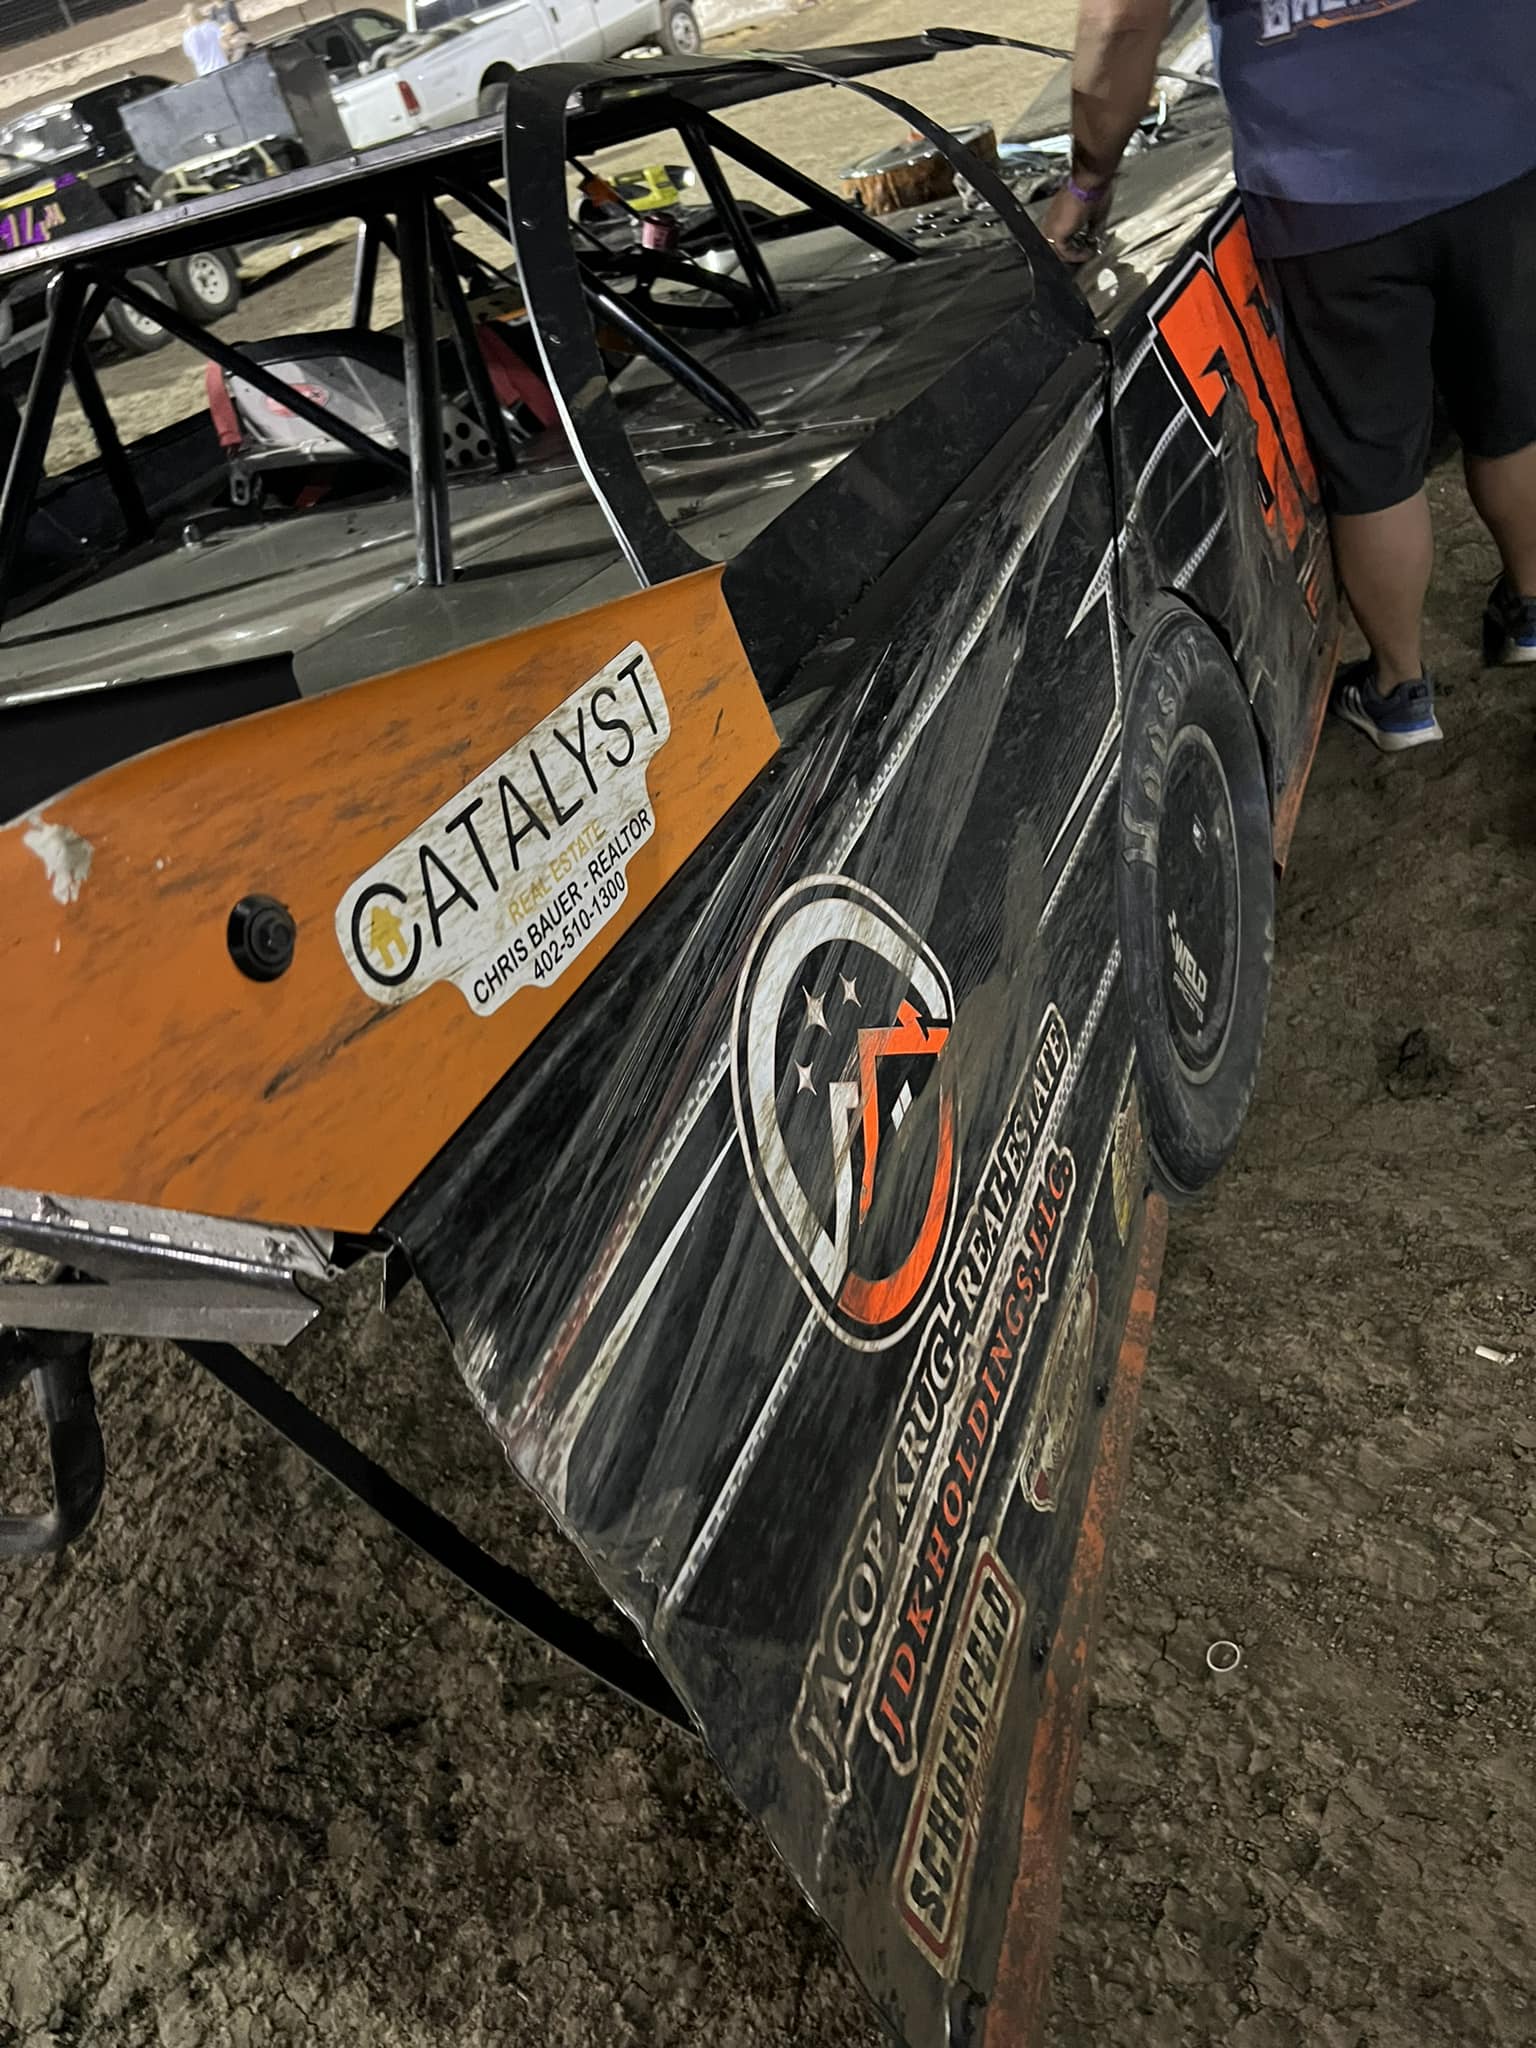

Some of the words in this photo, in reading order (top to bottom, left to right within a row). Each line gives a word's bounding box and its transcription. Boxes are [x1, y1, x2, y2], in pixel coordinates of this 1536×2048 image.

[351, 654, 658, 987] CATALYST
[473, 938, 529, 1004] CHRIS
[527, 881, 583, 948] BAUER
[588, 808, 652, 885] REALTOR
[508, 876, 552, 926] REAL
[550, 818, 607, 882] ESTATE
[534, 870, 626, 981] 402-510-1300
[1170, 931, 1208, 1003] WELD
[894, 1333, 955, 1527] KRUG
[954, 1176, 1013, 1314] REAL
[1002, 1023, 1064, 1188] ESTATE
[880, 1584, 934, 1746] JDK
[926, 1263, 1042, 1534] HOLDINGS,
[1028, 1163, 1071, 1260] LLC.
[910, 1577, 1011, 1934] SCHOENFELD
